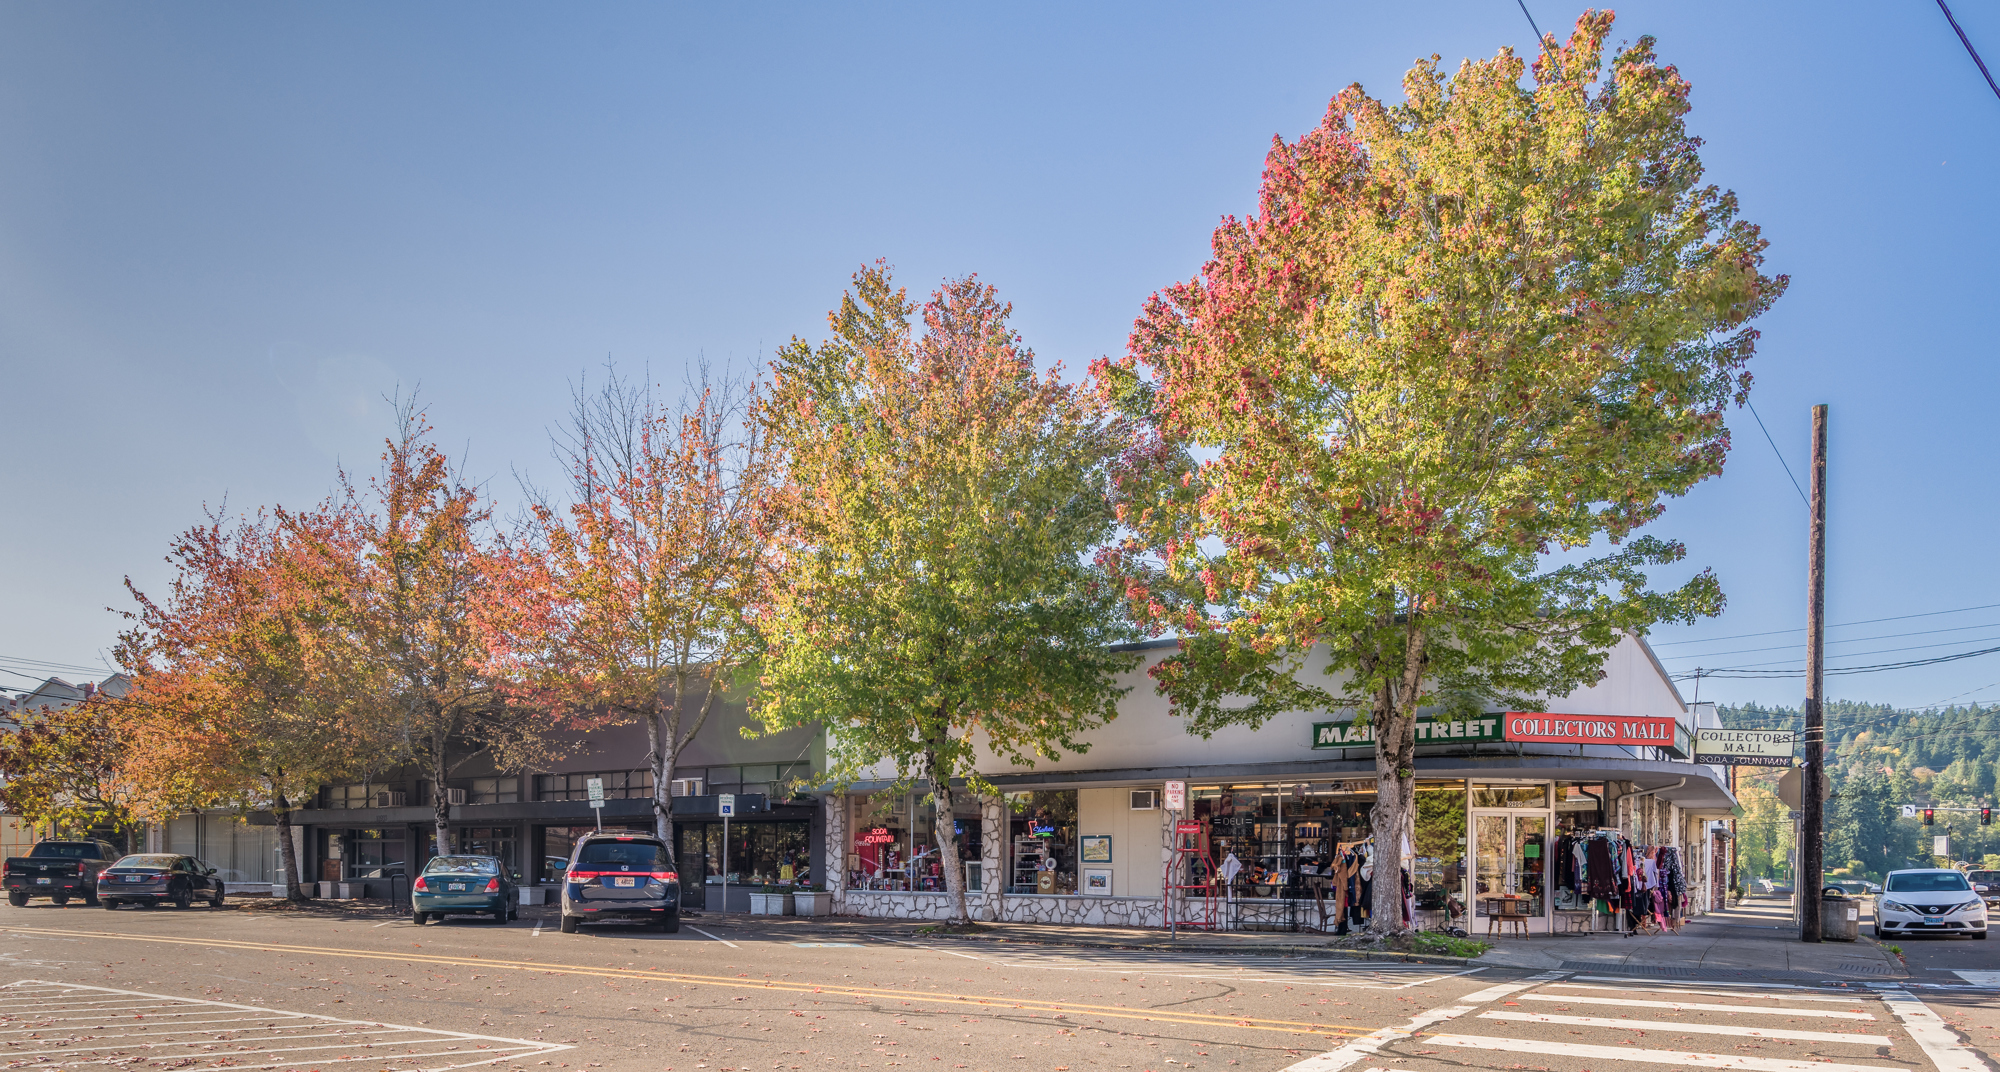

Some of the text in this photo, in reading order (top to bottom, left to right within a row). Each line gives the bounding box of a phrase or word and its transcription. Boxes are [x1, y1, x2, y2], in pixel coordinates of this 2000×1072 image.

[1318, 719, 1496, 744] MAI TREET
[1511, 718, 1670, 740] COLLECTORS MALL
[1701, 732, 1790, 743] COLLECTORS
[1723, 743, 1765, 753] MALL
[1732, 756, 1788, 766] FOUNTAIN
[1222, 817, 1244, 825] DELI
[864, 835, 894, 843] FOUNTAIN
